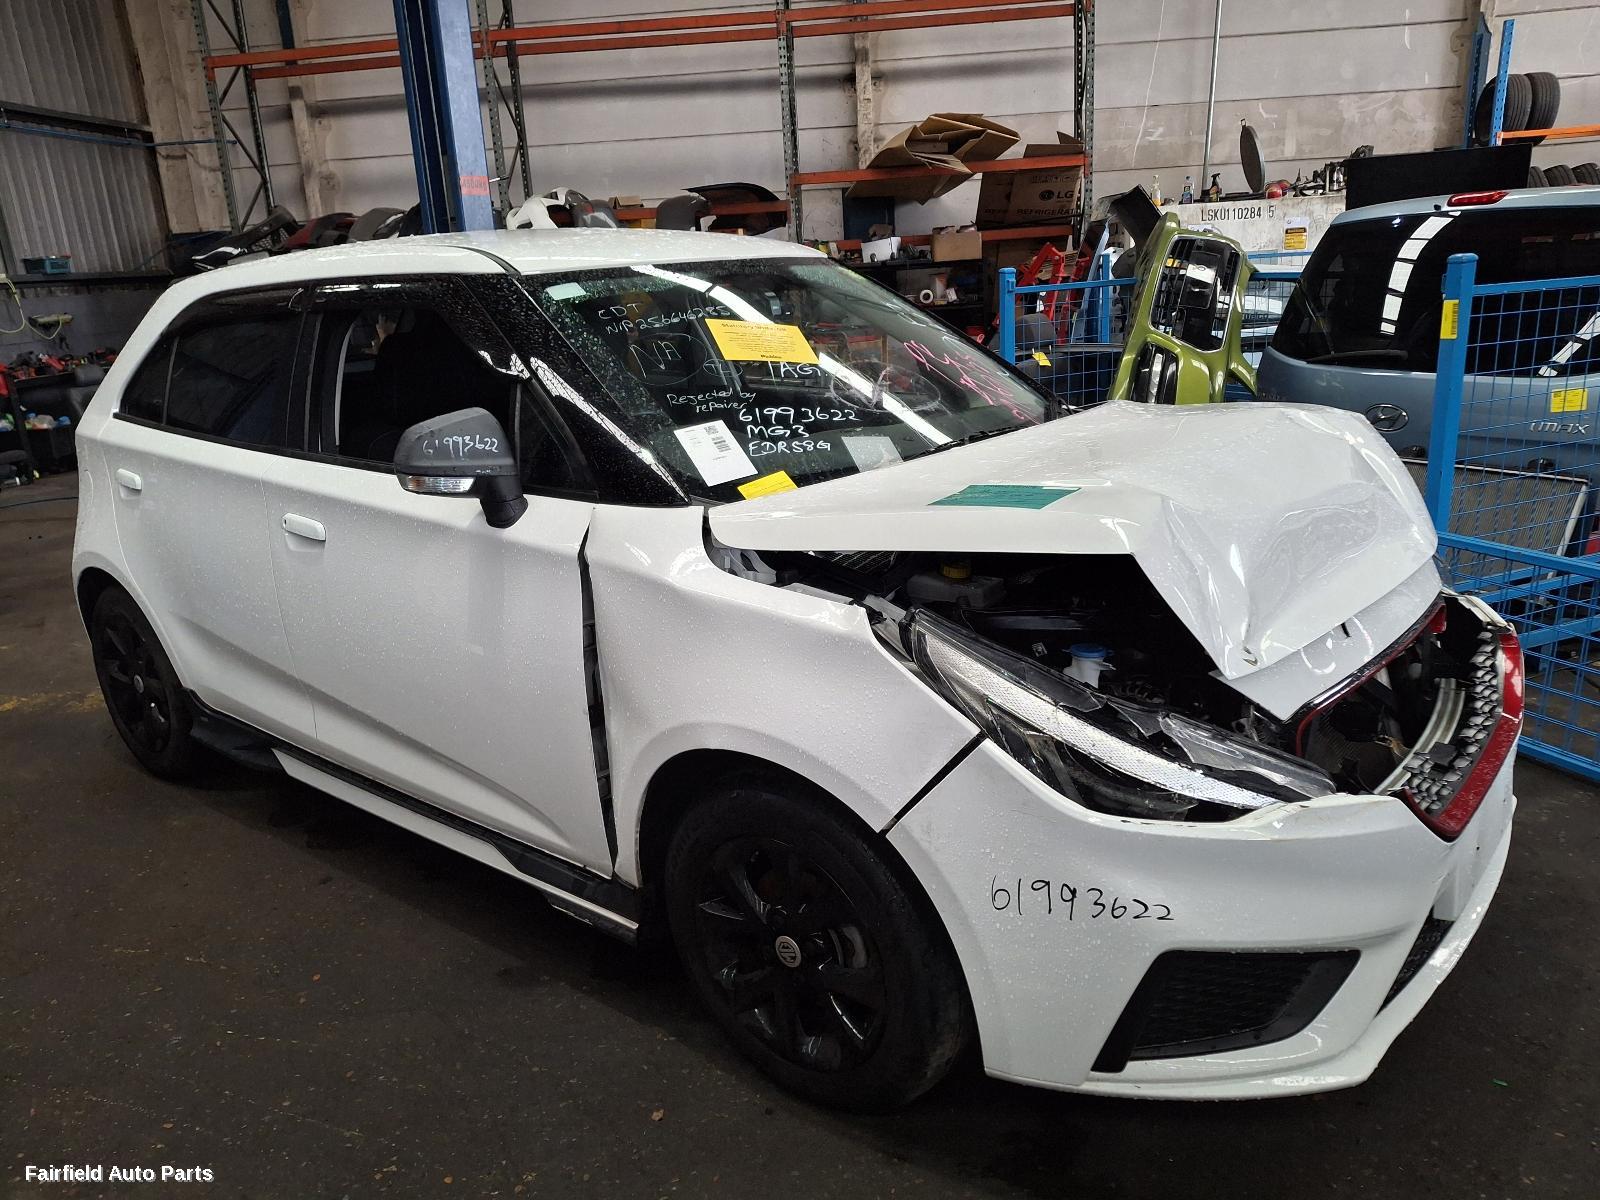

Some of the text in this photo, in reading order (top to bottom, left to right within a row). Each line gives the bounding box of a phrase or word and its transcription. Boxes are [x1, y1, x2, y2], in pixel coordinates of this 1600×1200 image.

[1056, 190, 1075, 199] LG
[1201, 206, 1262, 222] LSKU110284
[666, 387, 757, 406] Rejected by
[746, 424, 810, 439] MG3
[422, 434, 499, 459] 61993622
[991, 874, 1175, 921] 61993622
